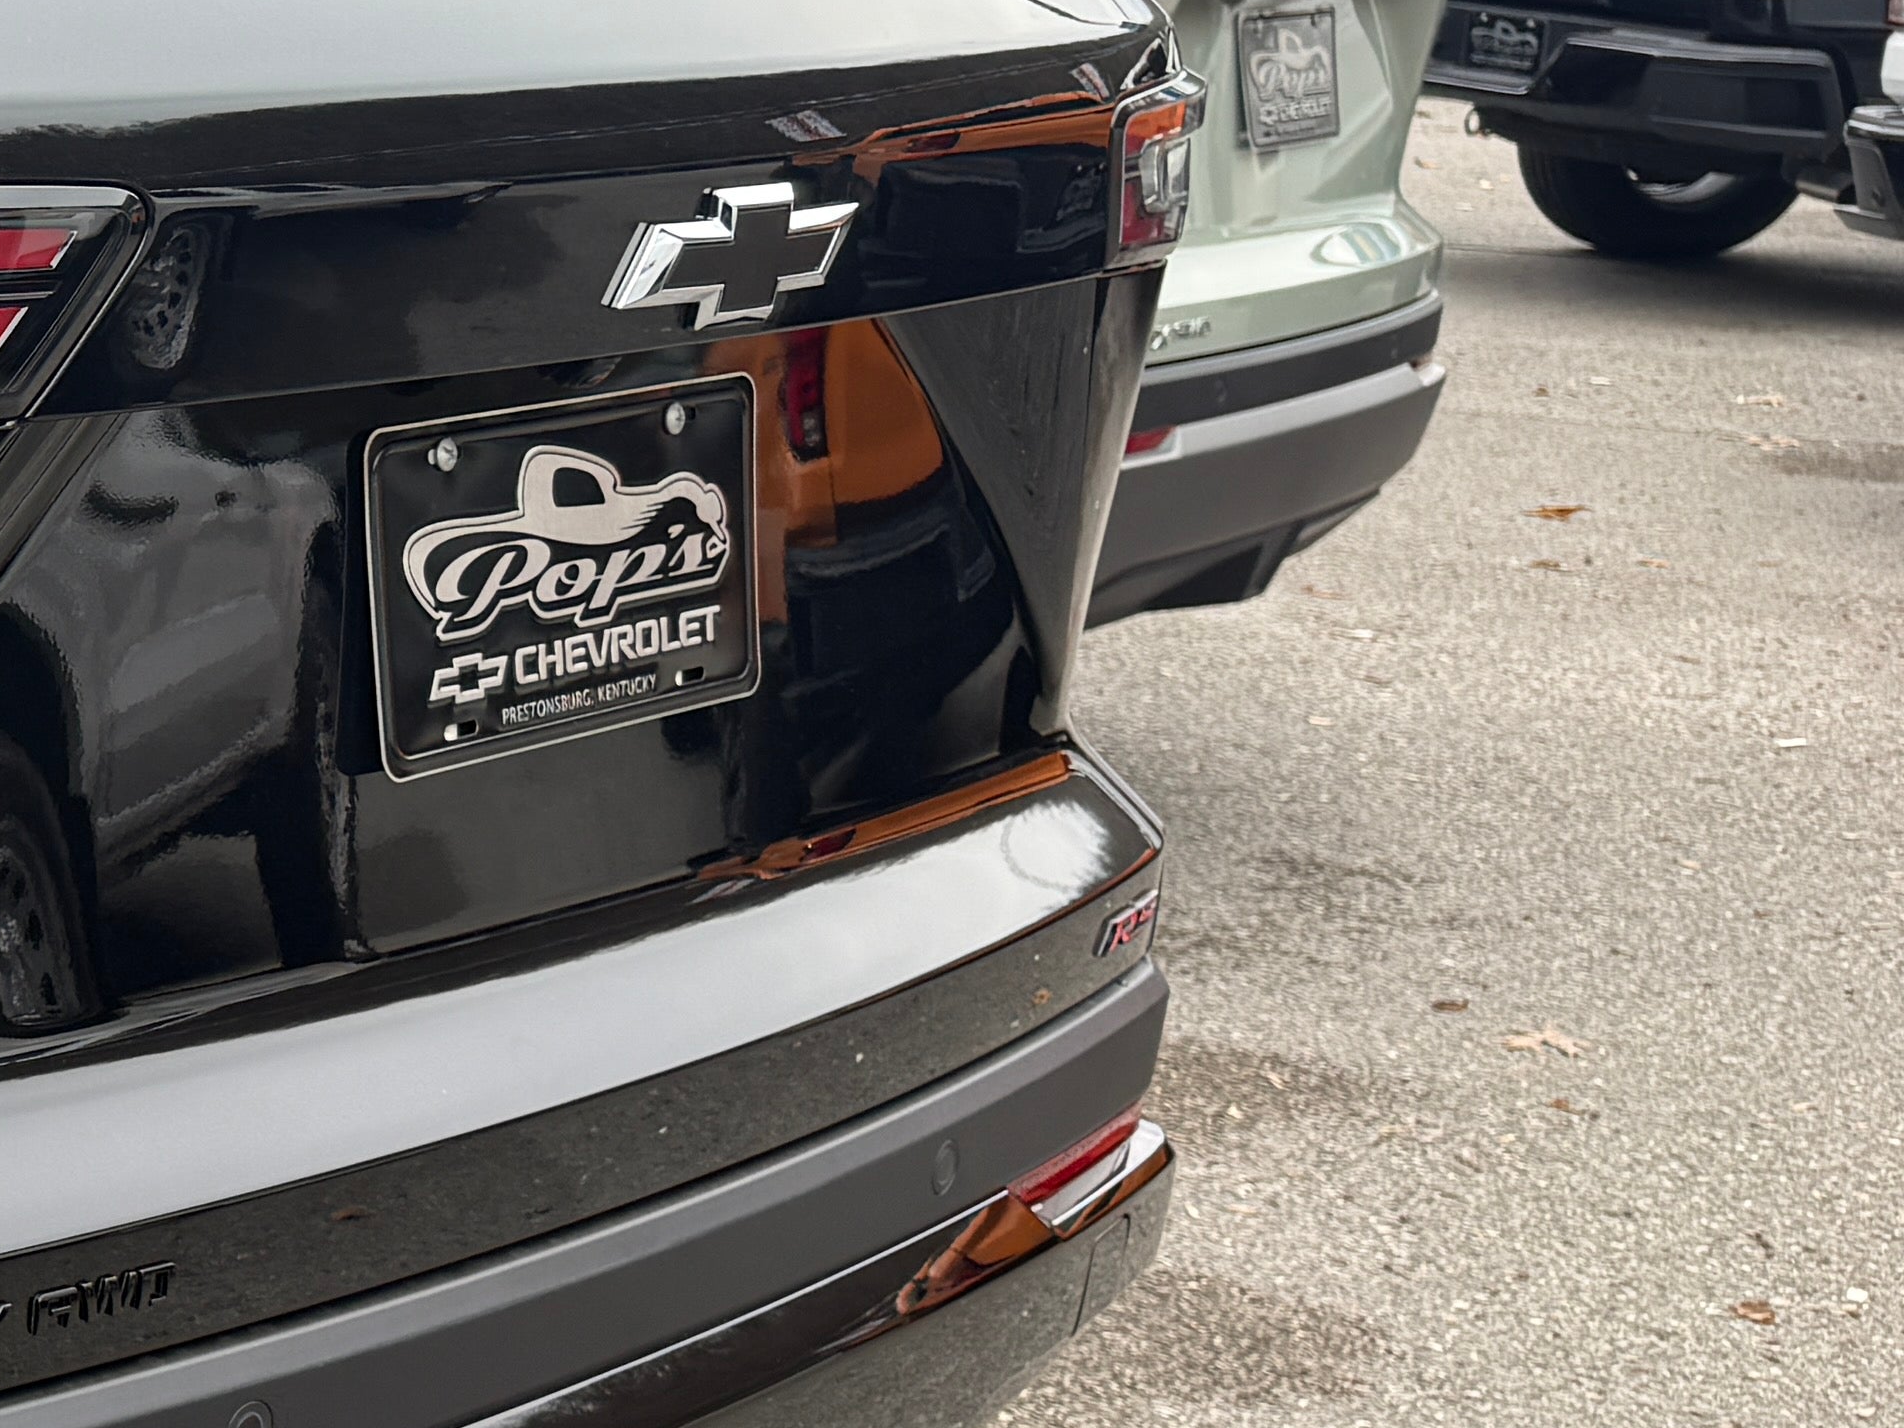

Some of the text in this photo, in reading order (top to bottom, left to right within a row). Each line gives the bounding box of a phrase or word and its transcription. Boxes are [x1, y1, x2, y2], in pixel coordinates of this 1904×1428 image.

[435, 523, 715, 623] Pop's
[513, 604, 722, 685] CHEVROLET
[501, 673, 657, 726] PRESTONSBURG, KENTUCKY
